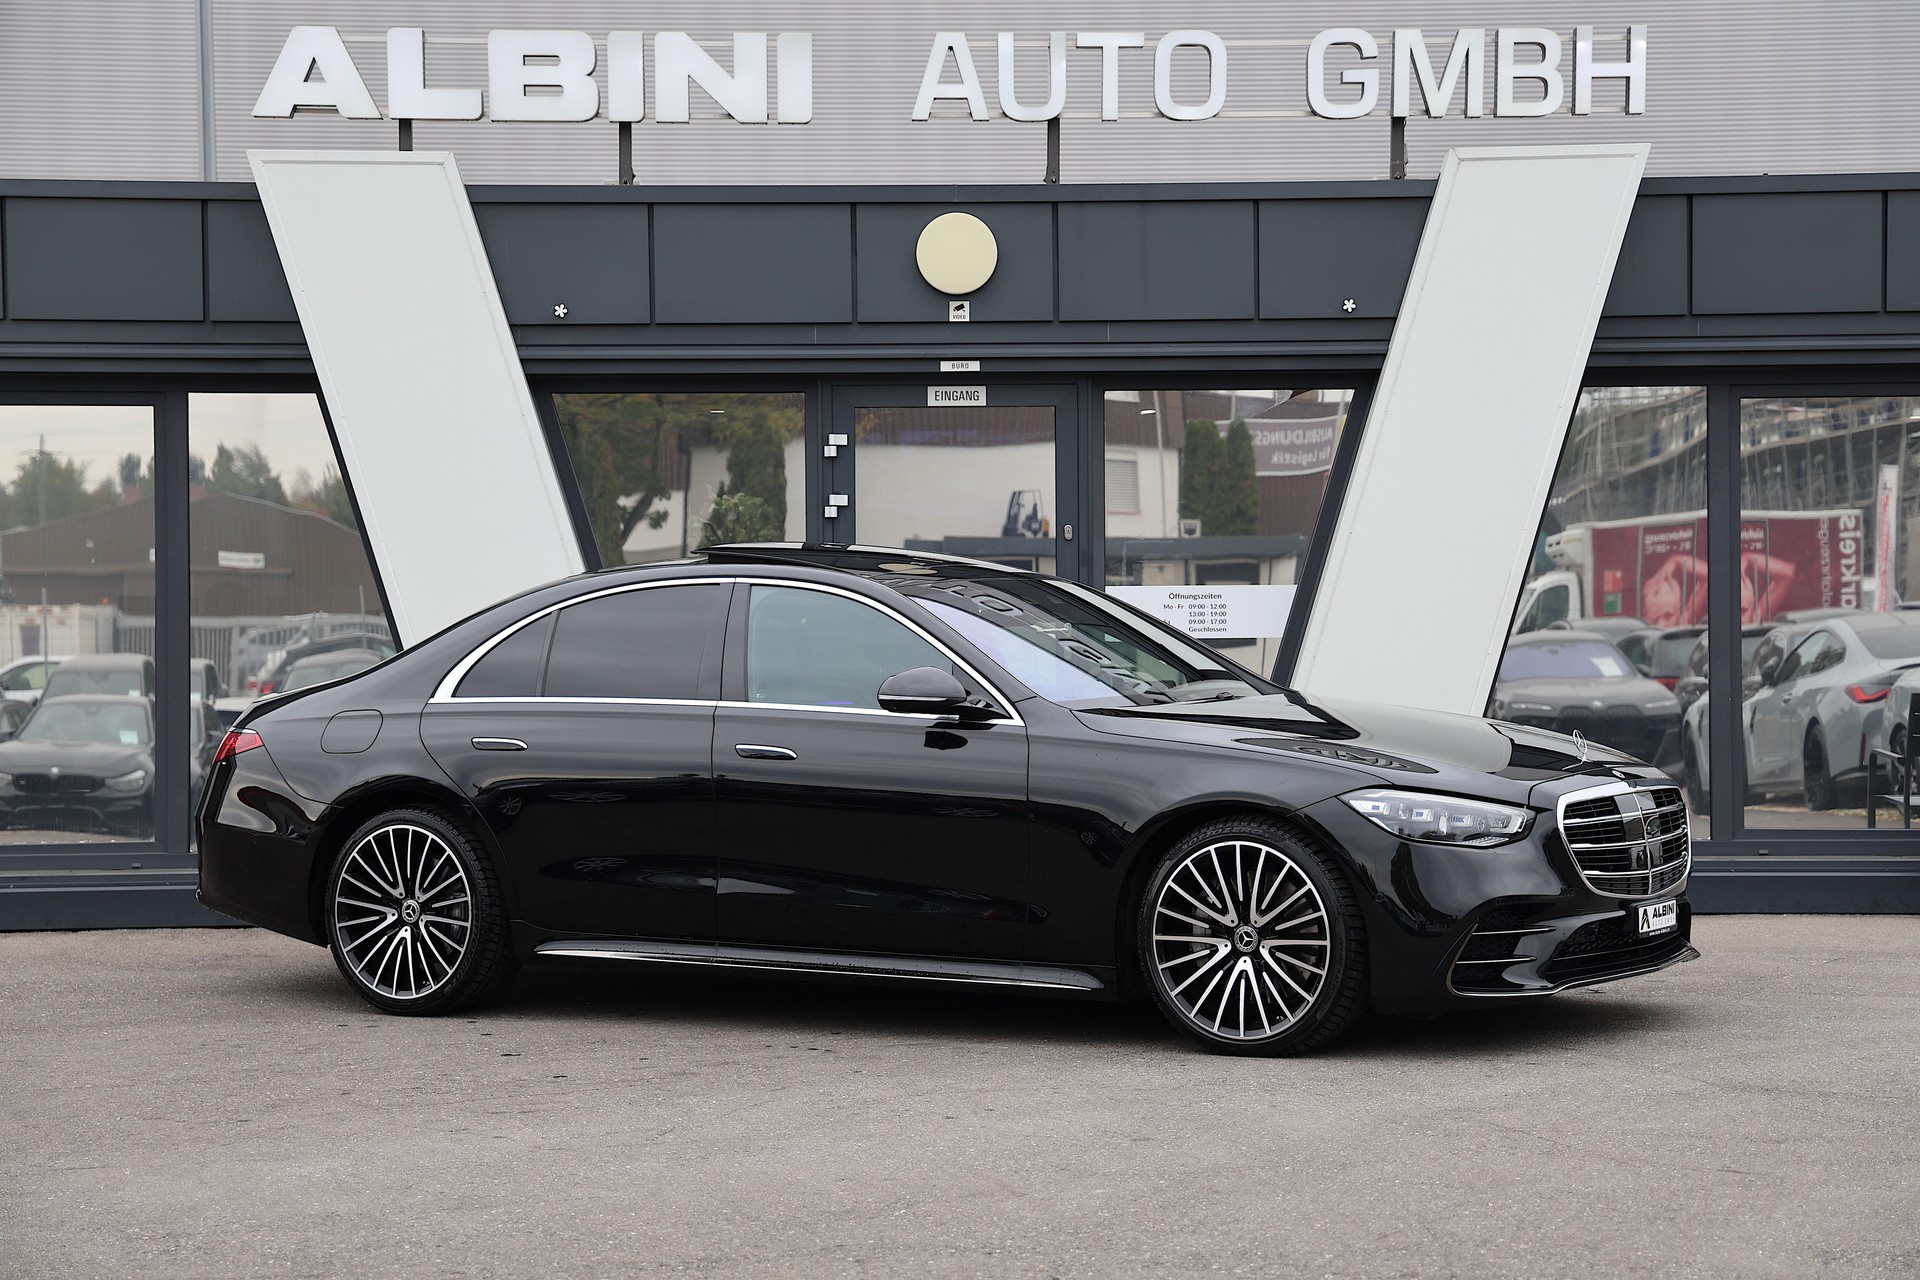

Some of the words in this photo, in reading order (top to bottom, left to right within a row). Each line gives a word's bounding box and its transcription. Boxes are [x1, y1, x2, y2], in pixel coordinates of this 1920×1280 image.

[251, 25, 813, 124] ALBINI
[912, 29, 1228, 122] AUTO
[1306, 25, 1647, 119] GMBH
[934, 390, 980, 401] EINGANG
[1168, 592, 1222, 600] Öffnungszeiten
[1652, 902, 1675, 919] ALBINI
